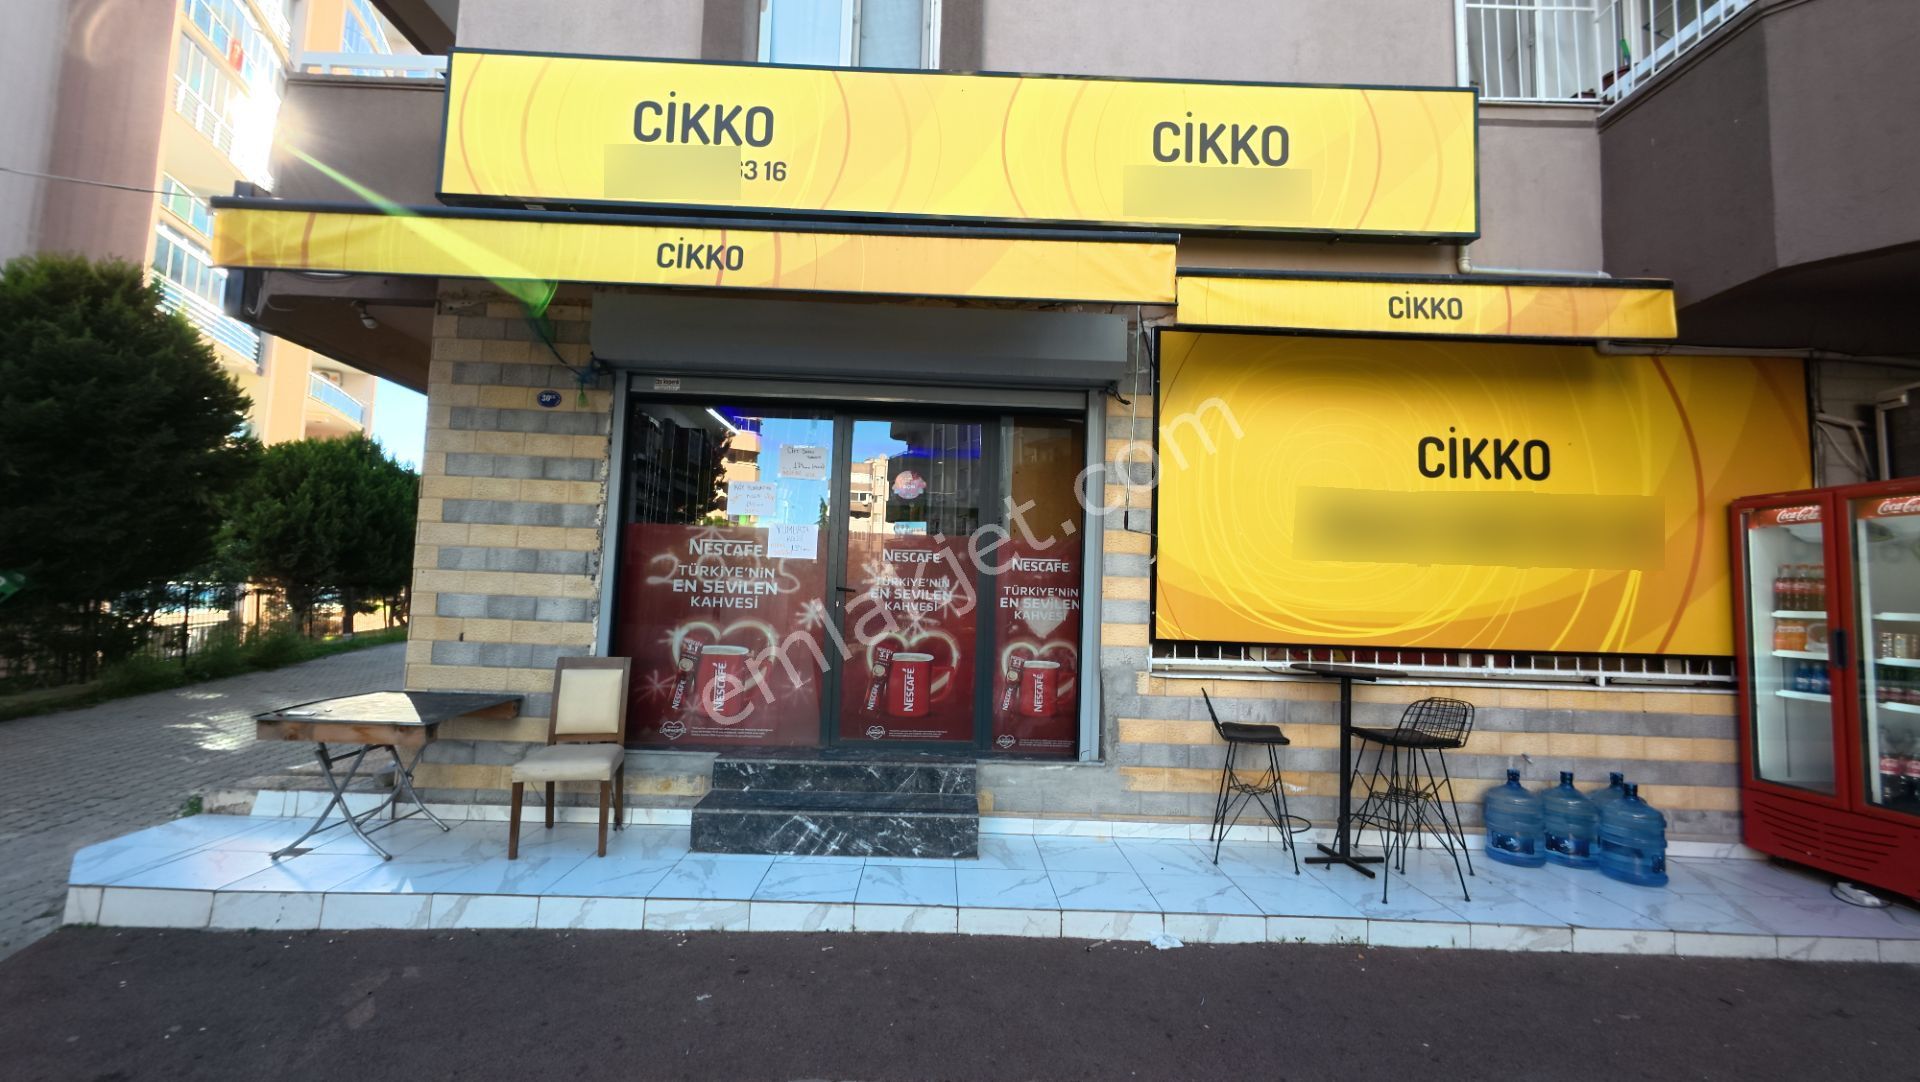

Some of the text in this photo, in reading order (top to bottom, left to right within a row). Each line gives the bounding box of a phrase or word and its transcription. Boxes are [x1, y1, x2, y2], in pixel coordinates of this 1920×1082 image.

[634, 91, 774, 148] CİKKO
[1153, 111, 1289, 167] CİKKO
[764, 161, 787, 181] 16
[656, 237, 744, 271] CİKKO
[1388, 291, 1463, 320] CİKKO
[1418, 426, 1550, 481] CİKKO
[672, 579, 697, 593] EN
[870, 588, 890, 599] EN
[690, 595, 758, 609] KAHVESİ
[1000, 597, 1019, 608] EN
